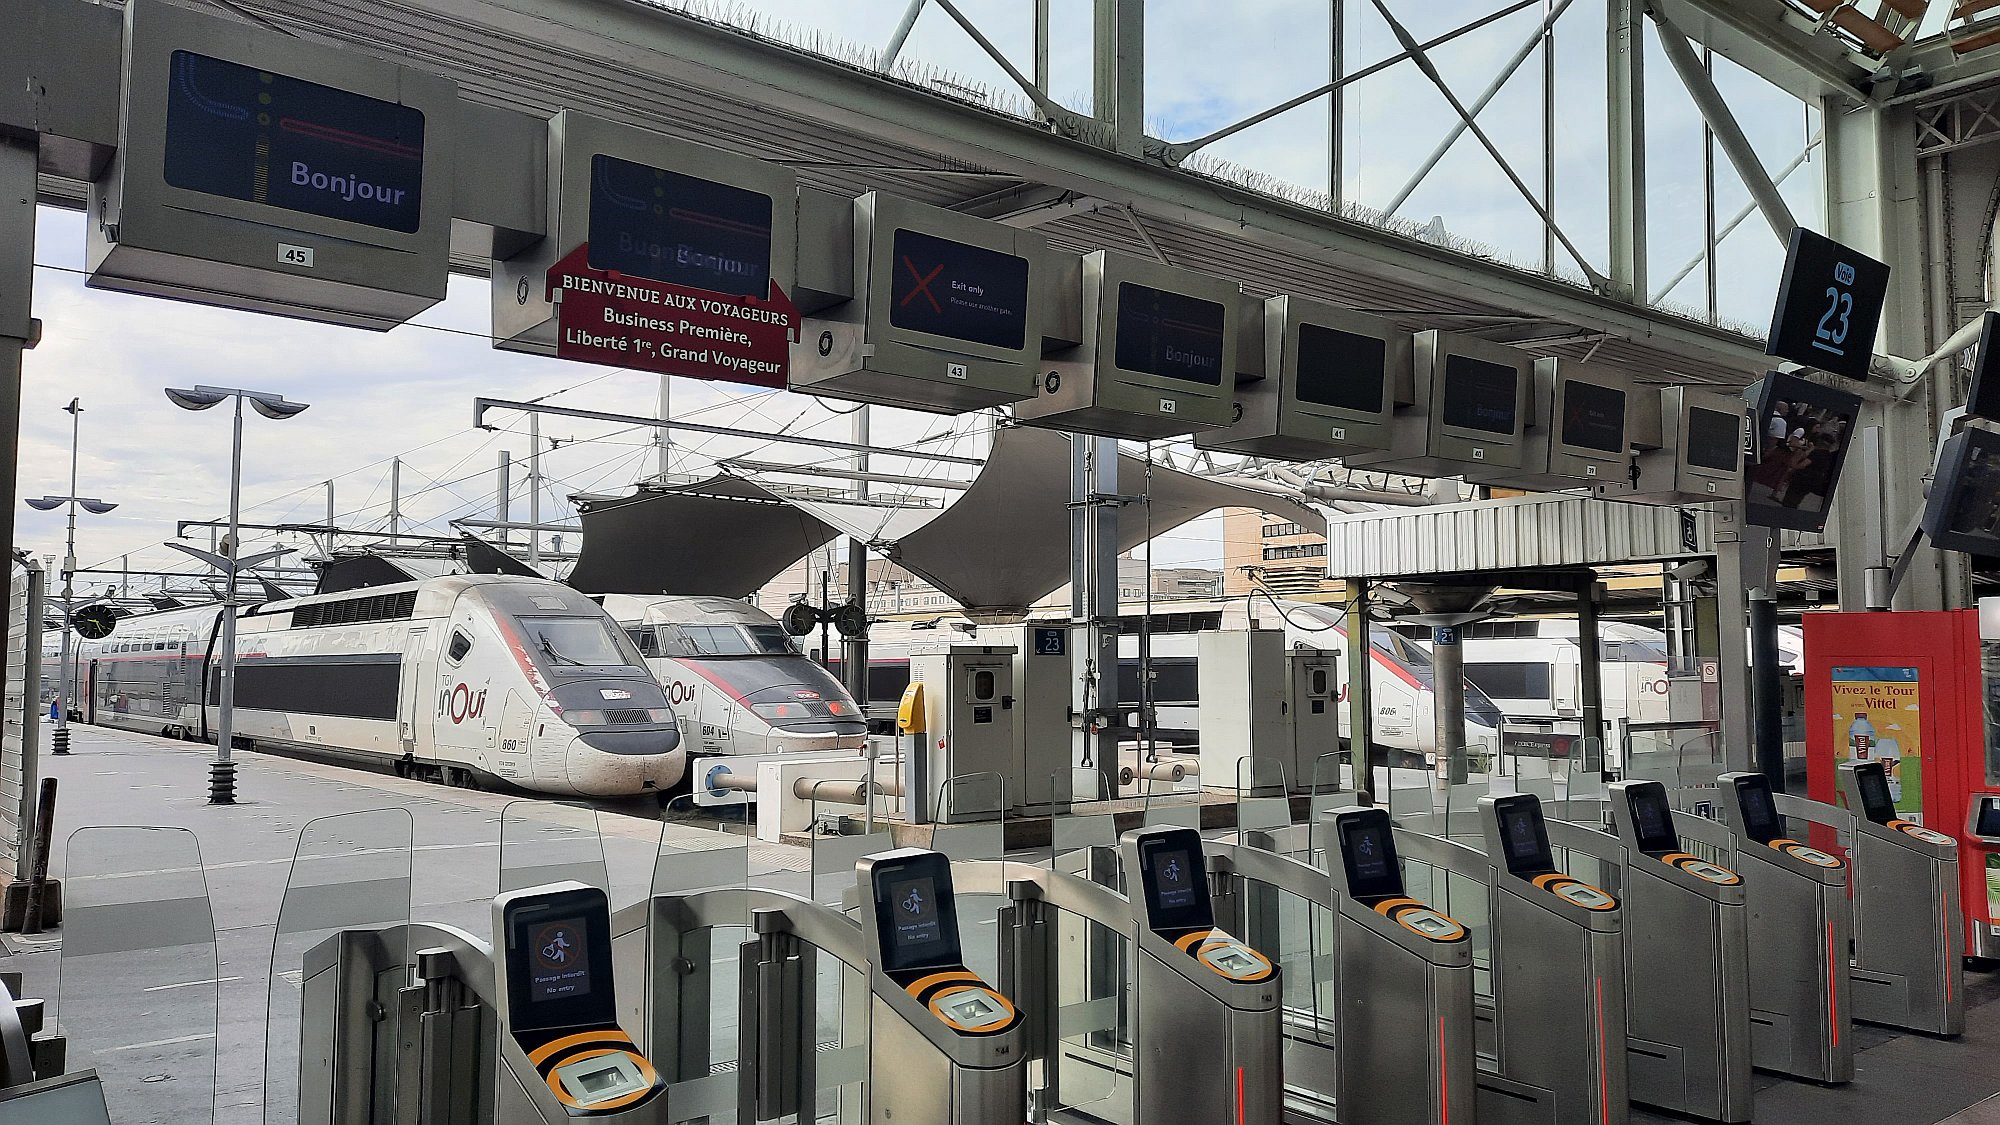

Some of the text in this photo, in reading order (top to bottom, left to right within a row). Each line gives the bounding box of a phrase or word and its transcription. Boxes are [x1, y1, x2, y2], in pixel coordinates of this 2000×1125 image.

[291, 160, 405, 206] Bonjour
[285, 249, 306, 263] 45
[1837, 264, 1853, 284] Voie
[951, 280, 984, 297] Exit only
[562, 274, 789, 327] BIENVENUE AUX VOYAGEURS
[950, 296, 967, 307] Please
[1815, 286, 1853, 345] 23
[603, 307, 753, 348] Business Première,
[566, 327, 628, 351] Liberté
[660, 342, 708, 363] Grand
[711, 351, 781, 375] Voyageur
[1165, 344, 1216, 368] Bonjour
[951, 366, 963, 378] 43
[1163, 402, 1173, 411] 42
[1334, 430, 1342, 438] 41
[1441, 632, 1454, 642] 21
[1045, 637, 1060, 651] 23
[441, 674, 455, 687] TGV
[1833, 685, 1915, 696] Vivez le Tour
[1864, 697, 1897, 710] Vittel
[702, 726, 715, 737] 604
[502, 738, 517, 751] 860
[534, 975, 561, 983] Passage
[558, 985, 576, 993] entry
